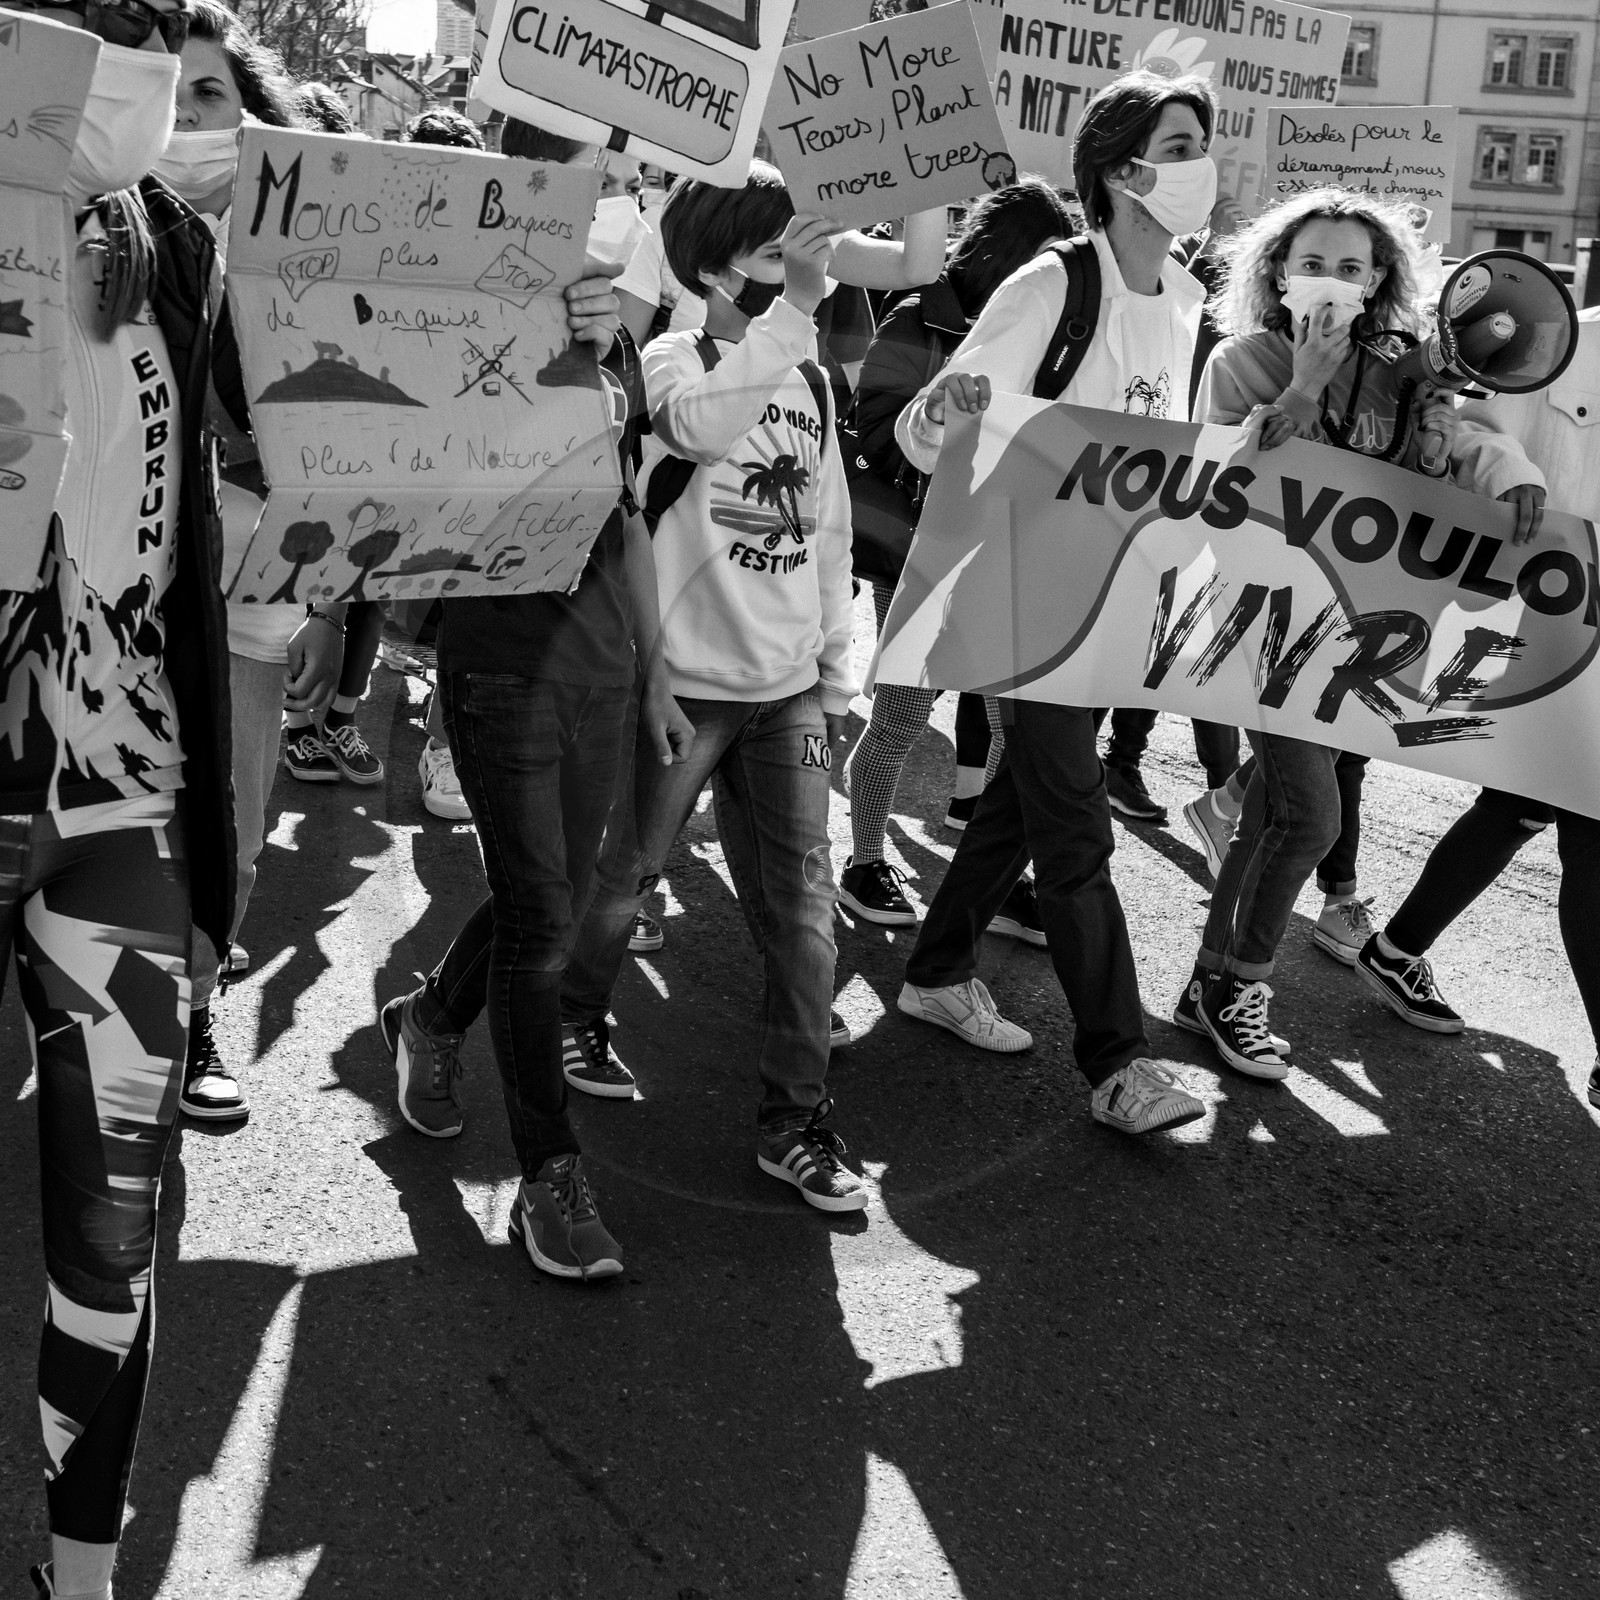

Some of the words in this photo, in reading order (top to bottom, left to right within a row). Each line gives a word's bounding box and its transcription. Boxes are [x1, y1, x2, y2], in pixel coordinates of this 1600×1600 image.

[1250, 6, 1287, 39] PAS
[1295, 17, 1322, 45] LA
[783, 54, 844, 105] No
[859, 36, 960, 88] More
[1000, 14, 1123, 70] NATURE
[1222, 58, 1274, 95] NOUS
[1277, 70, 1338, 103] SOMMES
[778, 116, 885, 156] Tears,
[892, 84, 981, 130] Plant
[1278, 114, 1346, 146] Désolés
[1351, 123, 1411, 152] pour
[1421, 119, 1444, 144] le
[817, 171, 898, 201] more
[904, 141, 990, 179] trees
[1277, 153, 1400, 182] dérangement,
[1402, 165, 1446, 179] nous
[250, 150, 381, 241] Moins
[414, 179, 452, 229] de
[1360, 177, 1378, 194] de
[1384, 180, 1445, 202] changer
[284, 253, 334, 291] STOP
[484, 254, 543, 290] STOP
[267, 298, 305, 331] de
[353, 293, 486, 347] Banquise
[1053, 345, 1069, 371] EASTPAK
[130, 349, 171, 555] EMBRUN
[411, 448, 436, 472] de
[467, 434, 559, 471] Nature
[1055, 442, 1257, 529] NOUS
[444, 499, 484, 537] de
[729, 542, 808, 574] FESTIVAL
[1143, 566, 1528, 747] VIVRE
